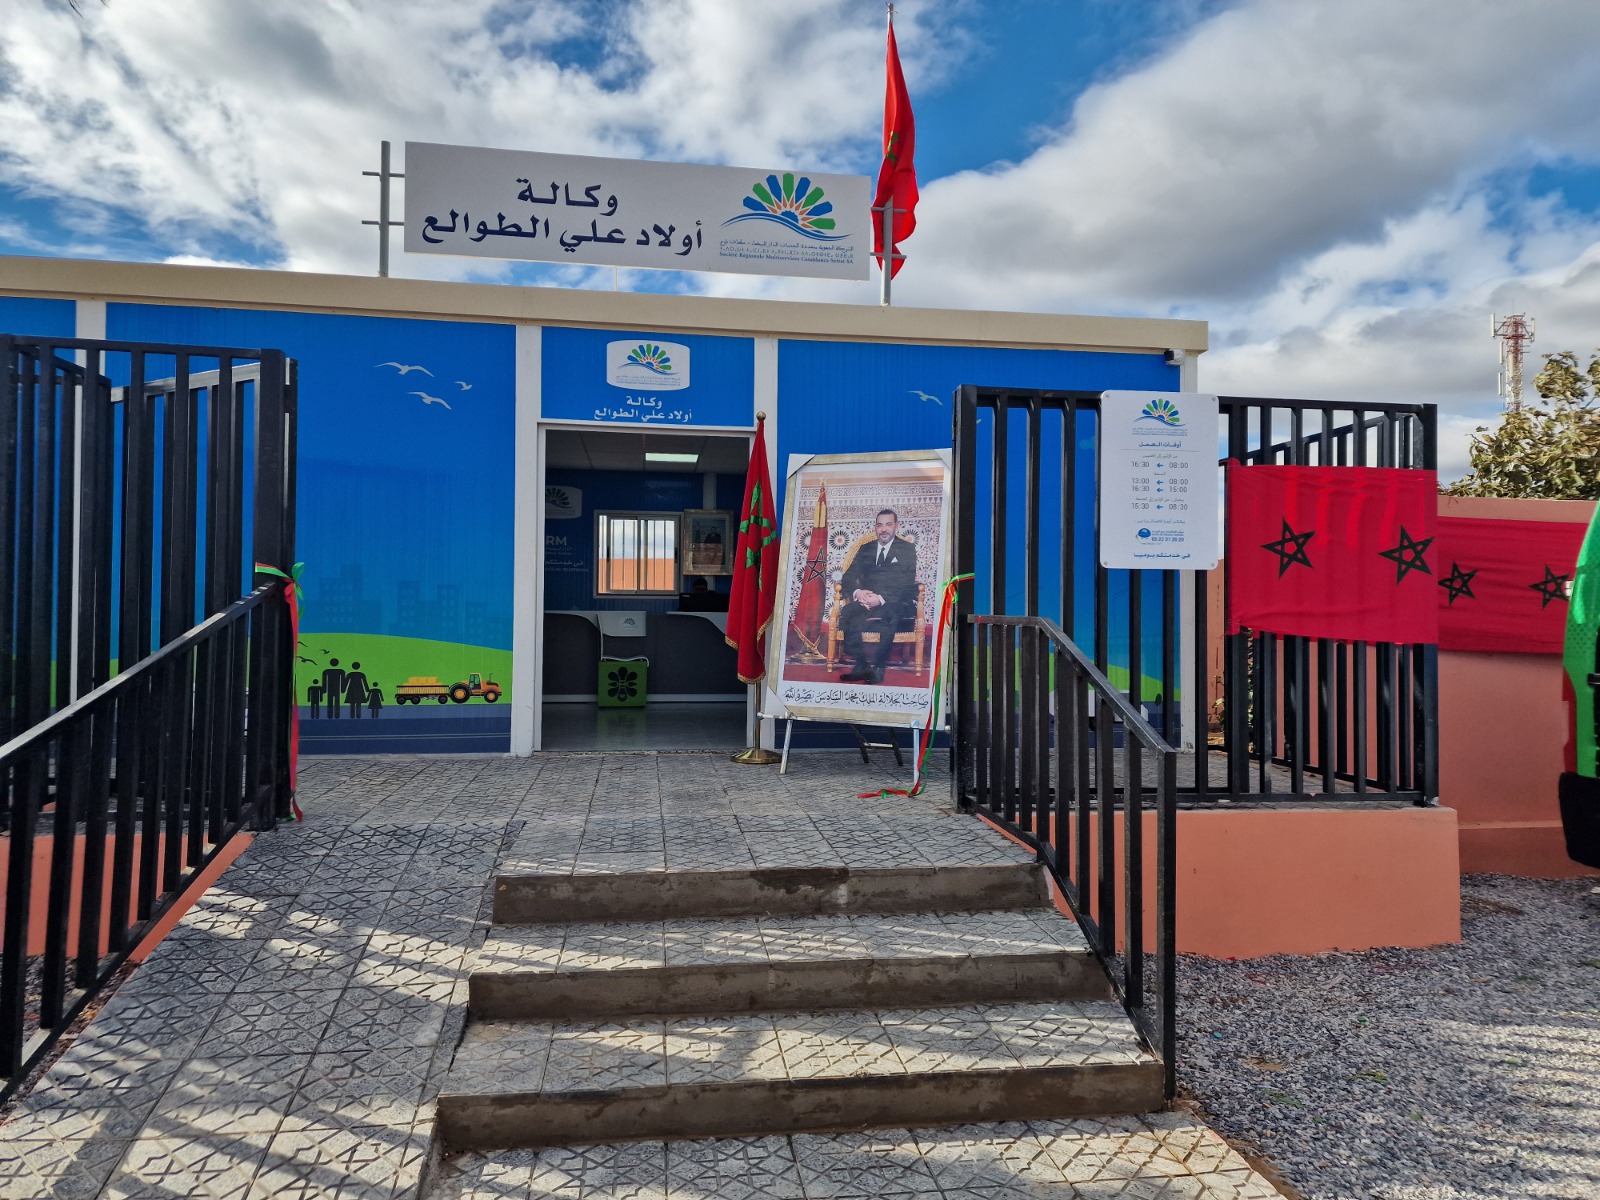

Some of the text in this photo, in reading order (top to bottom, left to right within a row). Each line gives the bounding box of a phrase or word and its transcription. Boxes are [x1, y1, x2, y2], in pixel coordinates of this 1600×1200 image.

[516, 177, 619, 217] وكالة
[421, 208, 703, 256] أولاد علي الطوالع
[625, 395, 663, 409] وكالة
[593, 406, 692, 423] أولاد علي الطوالع
[1131, 460, 1150, 468] 16:30
[1168, 461, 1189, 469] 08:00
[1168, 485, 1188, 493] 15:00
[1131, 502, 1150, 510] 15:30
[1168, 503, 1188, 511] 08:30
[546, 535, 567, 546] RM
